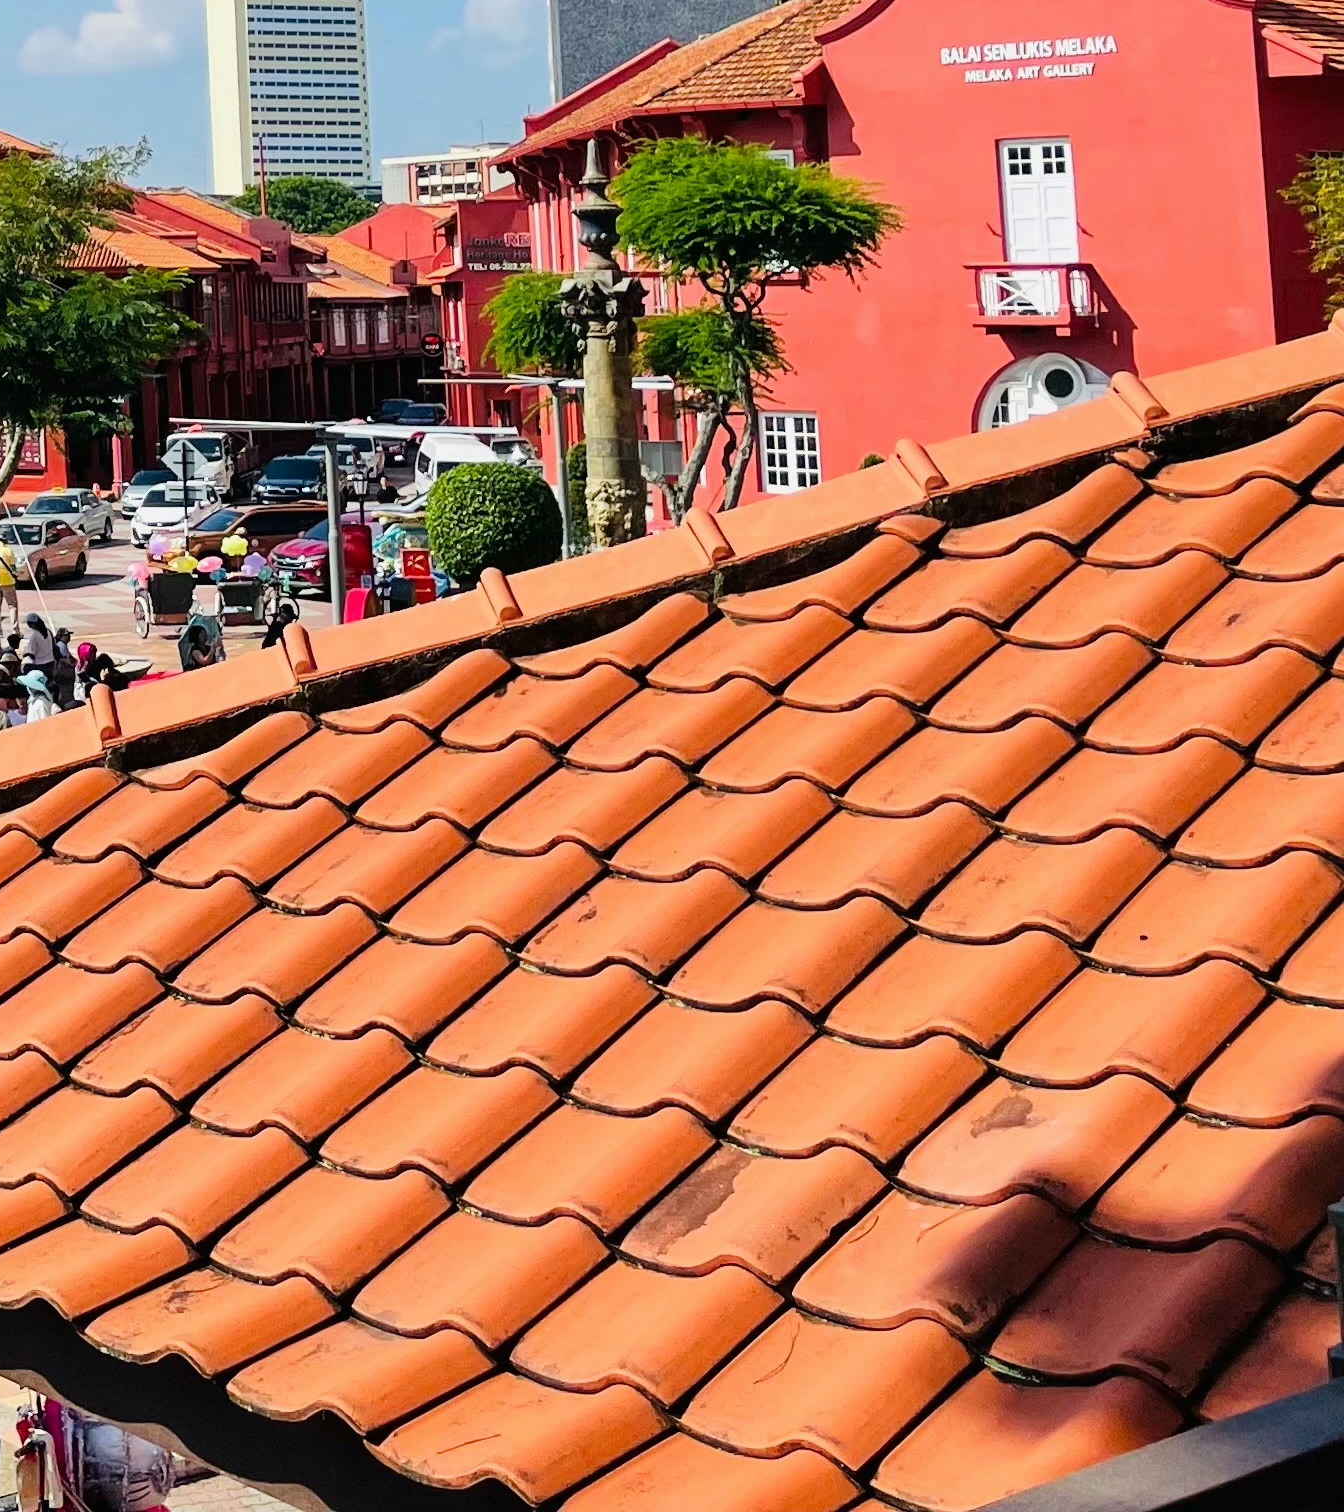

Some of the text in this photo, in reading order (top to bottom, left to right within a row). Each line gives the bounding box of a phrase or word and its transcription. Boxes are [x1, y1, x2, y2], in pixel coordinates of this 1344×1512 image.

[941, 35, 1118, 66] BALAI SENILUKIS MELAKA
[965, 62, 1095, 83] MELAKA ART GALLERY
